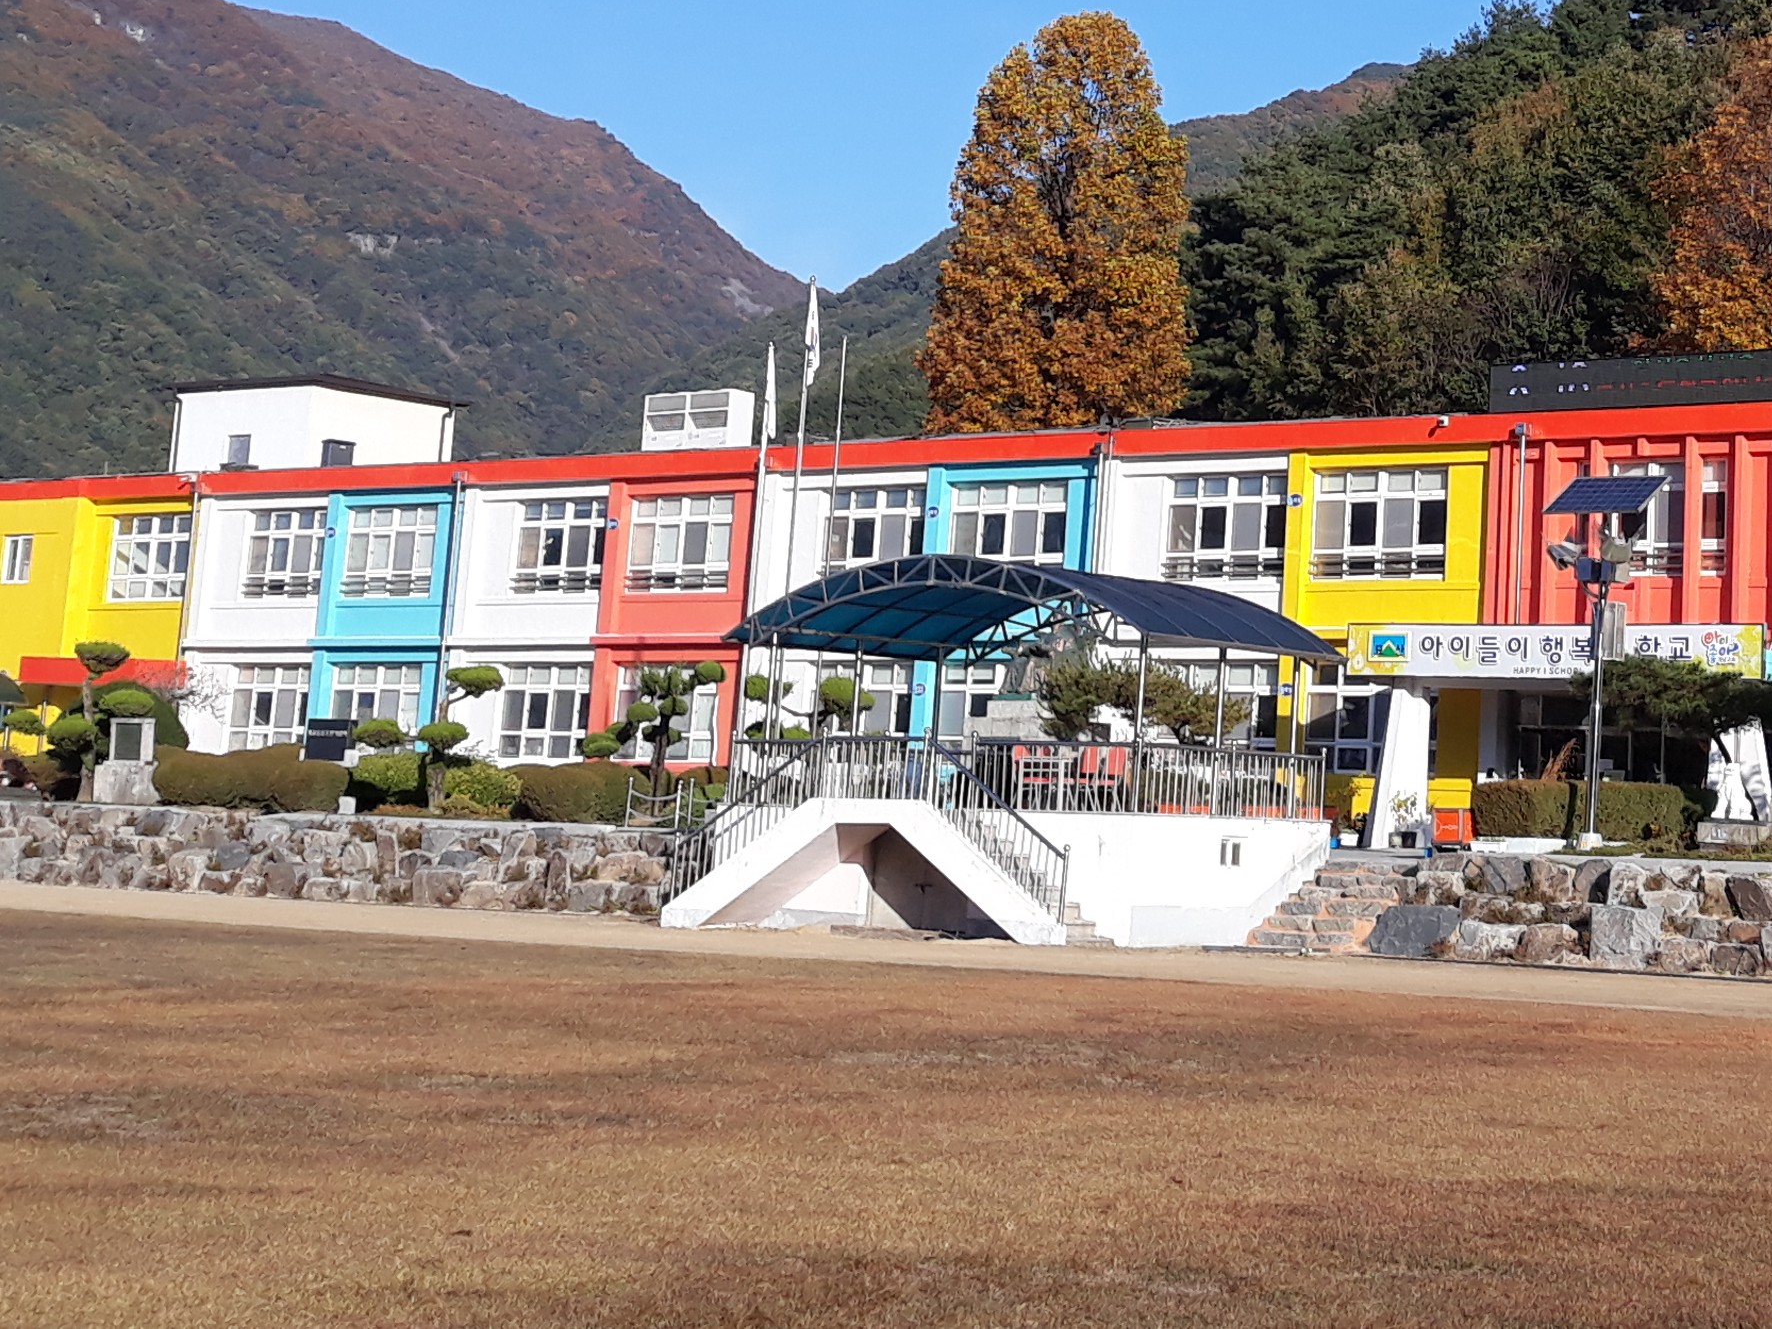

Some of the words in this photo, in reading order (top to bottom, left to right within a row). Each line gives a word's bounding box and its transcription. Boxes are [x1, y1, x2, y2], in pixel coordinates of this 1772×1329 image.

[1704, 630, 1729, 645] 아이
[1421, 635, 1529, 664] 아이들이
[1541, 635, 1598, 664] 행복
[1637, 634, 1693, 662] 학교
[1513, 666, 1541, 675] HAPPY
